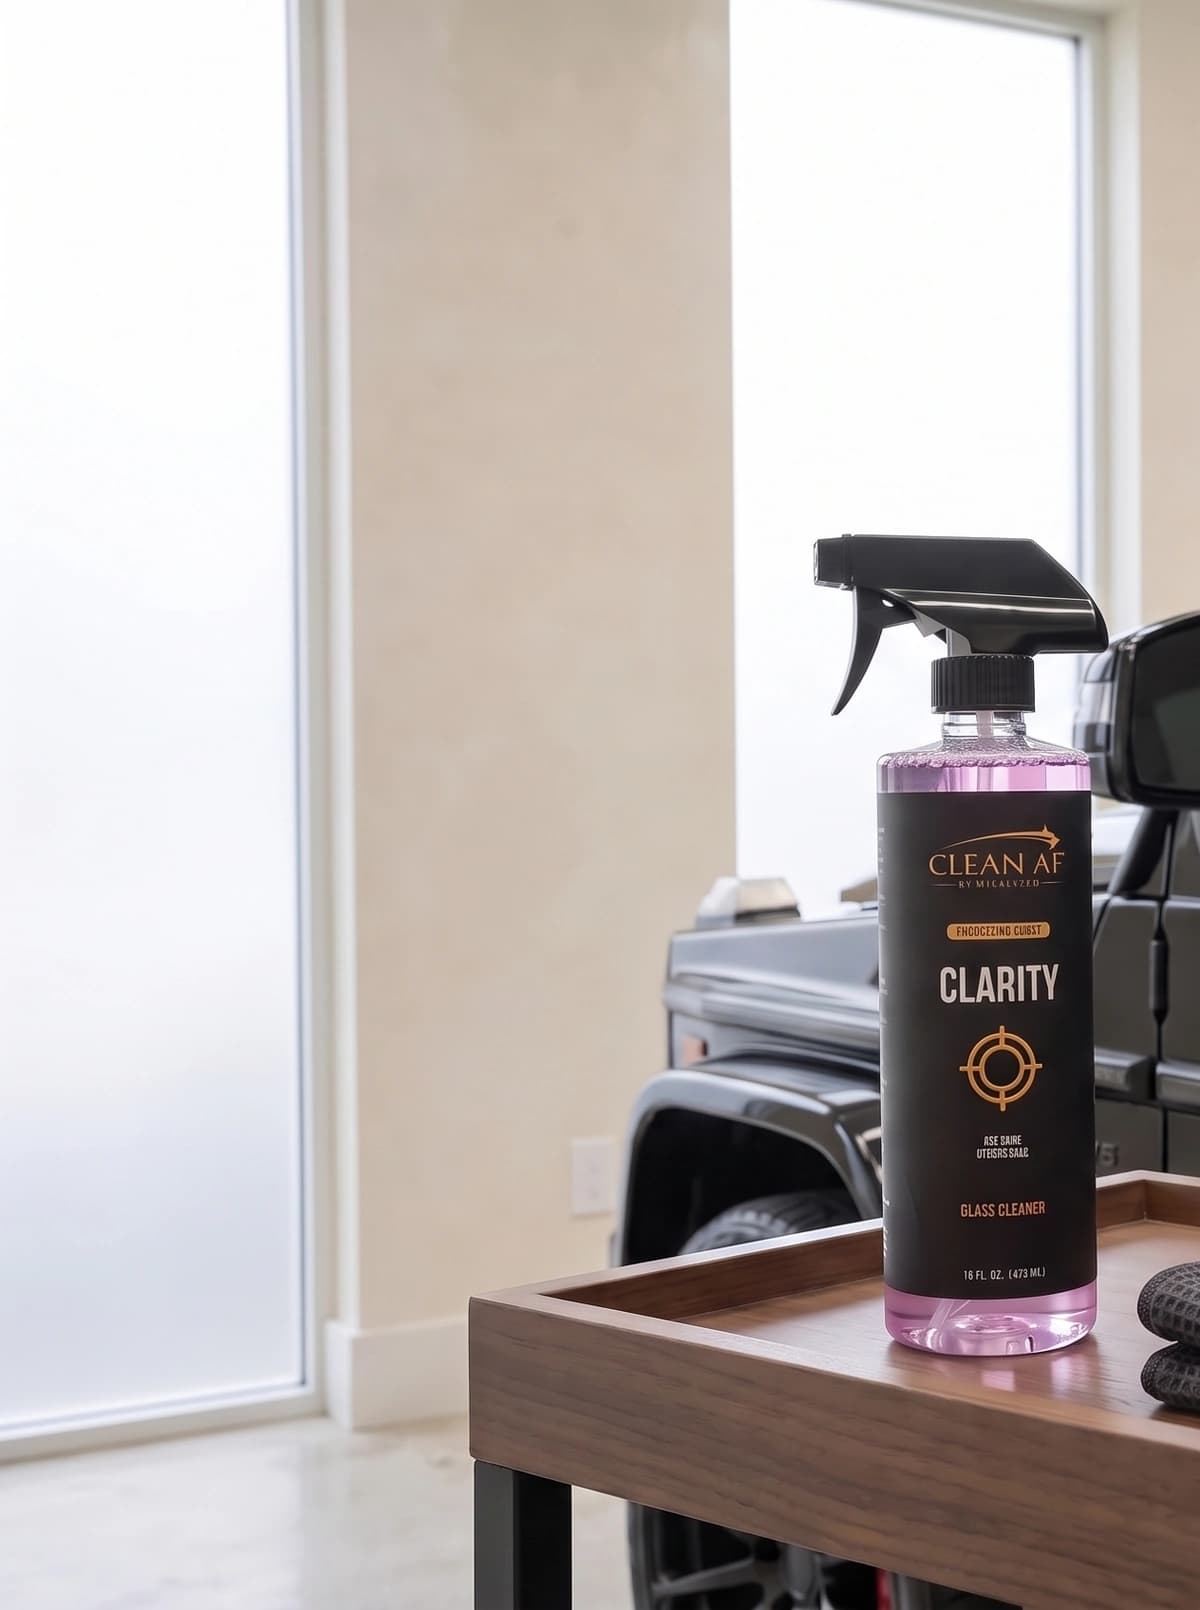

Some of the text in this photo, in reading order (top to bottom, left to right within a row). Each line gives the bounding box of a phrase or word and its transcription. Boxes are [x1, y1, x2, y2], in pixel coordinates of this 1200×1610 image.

[928, 851, 1065, 876] CLEAN AF
[939, 963, 1060, 1004] CLARITY
[960, 1200, 1046, 1218] GLASS CLEANER
[990, 1269, 1005, 1280] OZ.
[1008, 1268, 1028, 1280] (473
